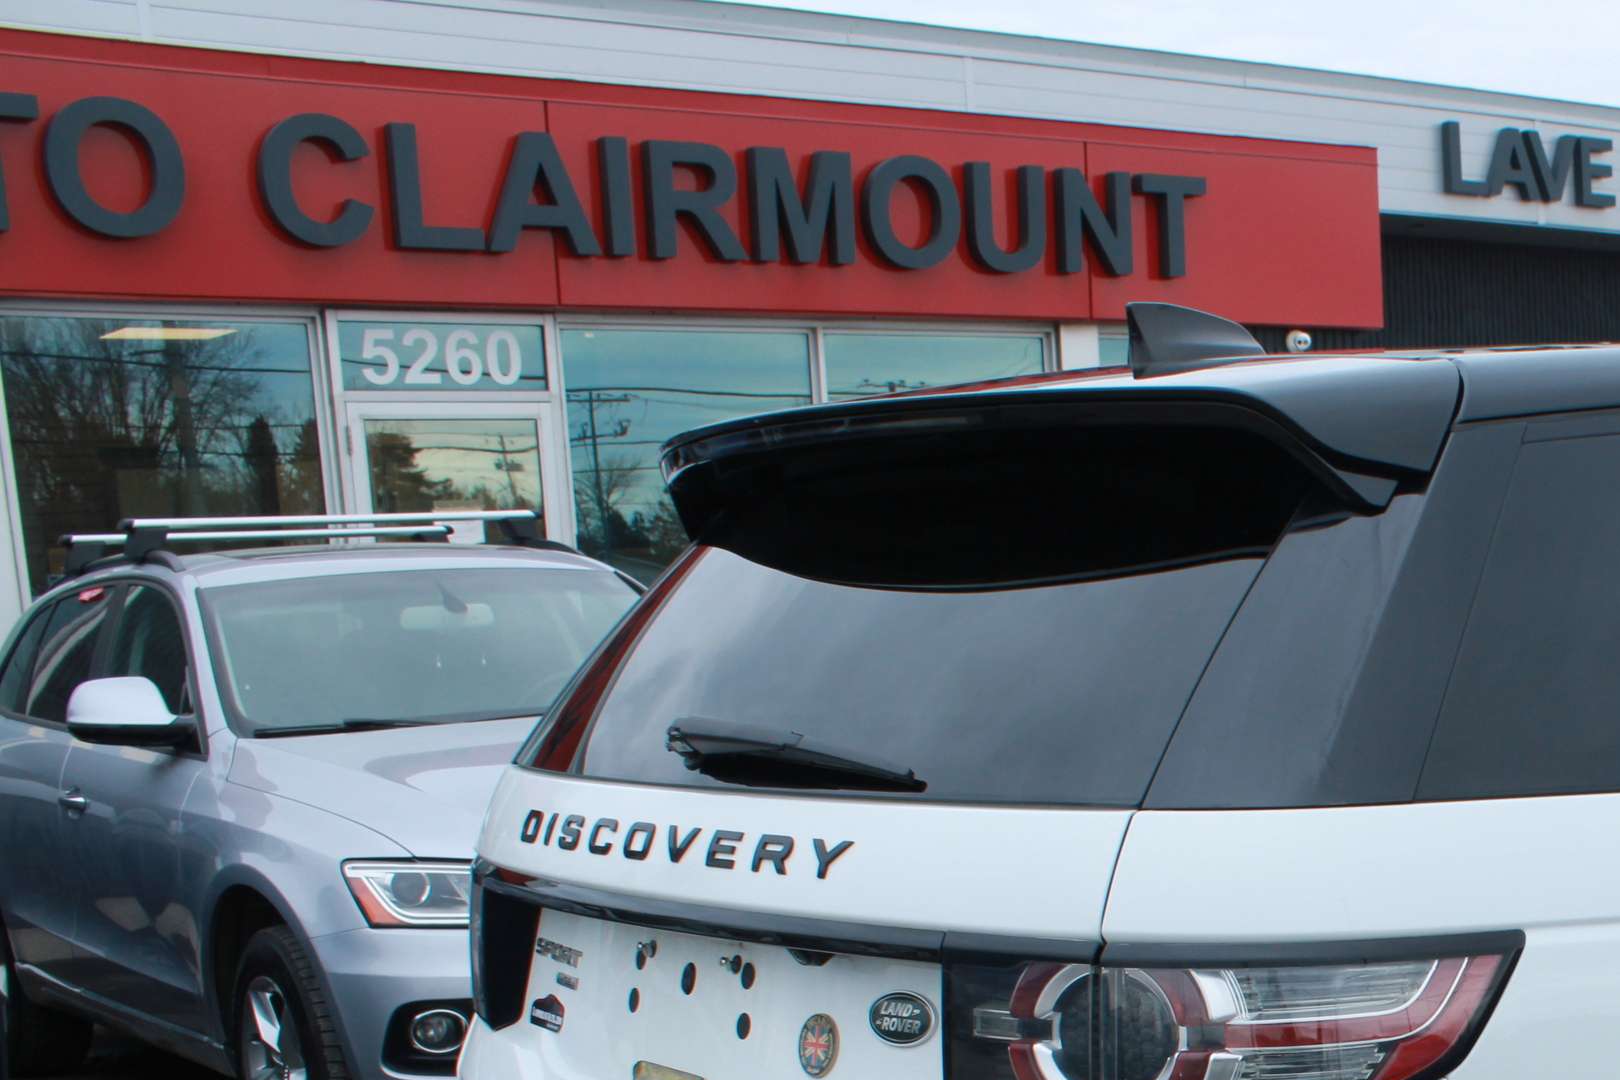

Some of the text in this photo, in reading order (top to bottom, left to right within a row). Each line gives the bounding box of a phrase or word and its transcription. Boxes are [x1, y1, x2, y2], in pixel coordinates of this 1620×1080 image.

[256, 112, 1206, 279] CLAIRMOUNT
[1440, 121, 1616, 208] LAVE
[360, 328, 522, 386] 5260
[520, 808, 855, 880] DISCOVERY
[880, 1001, 913, 1017] LAND
[881, 1017, 921, 1034] ROVER
